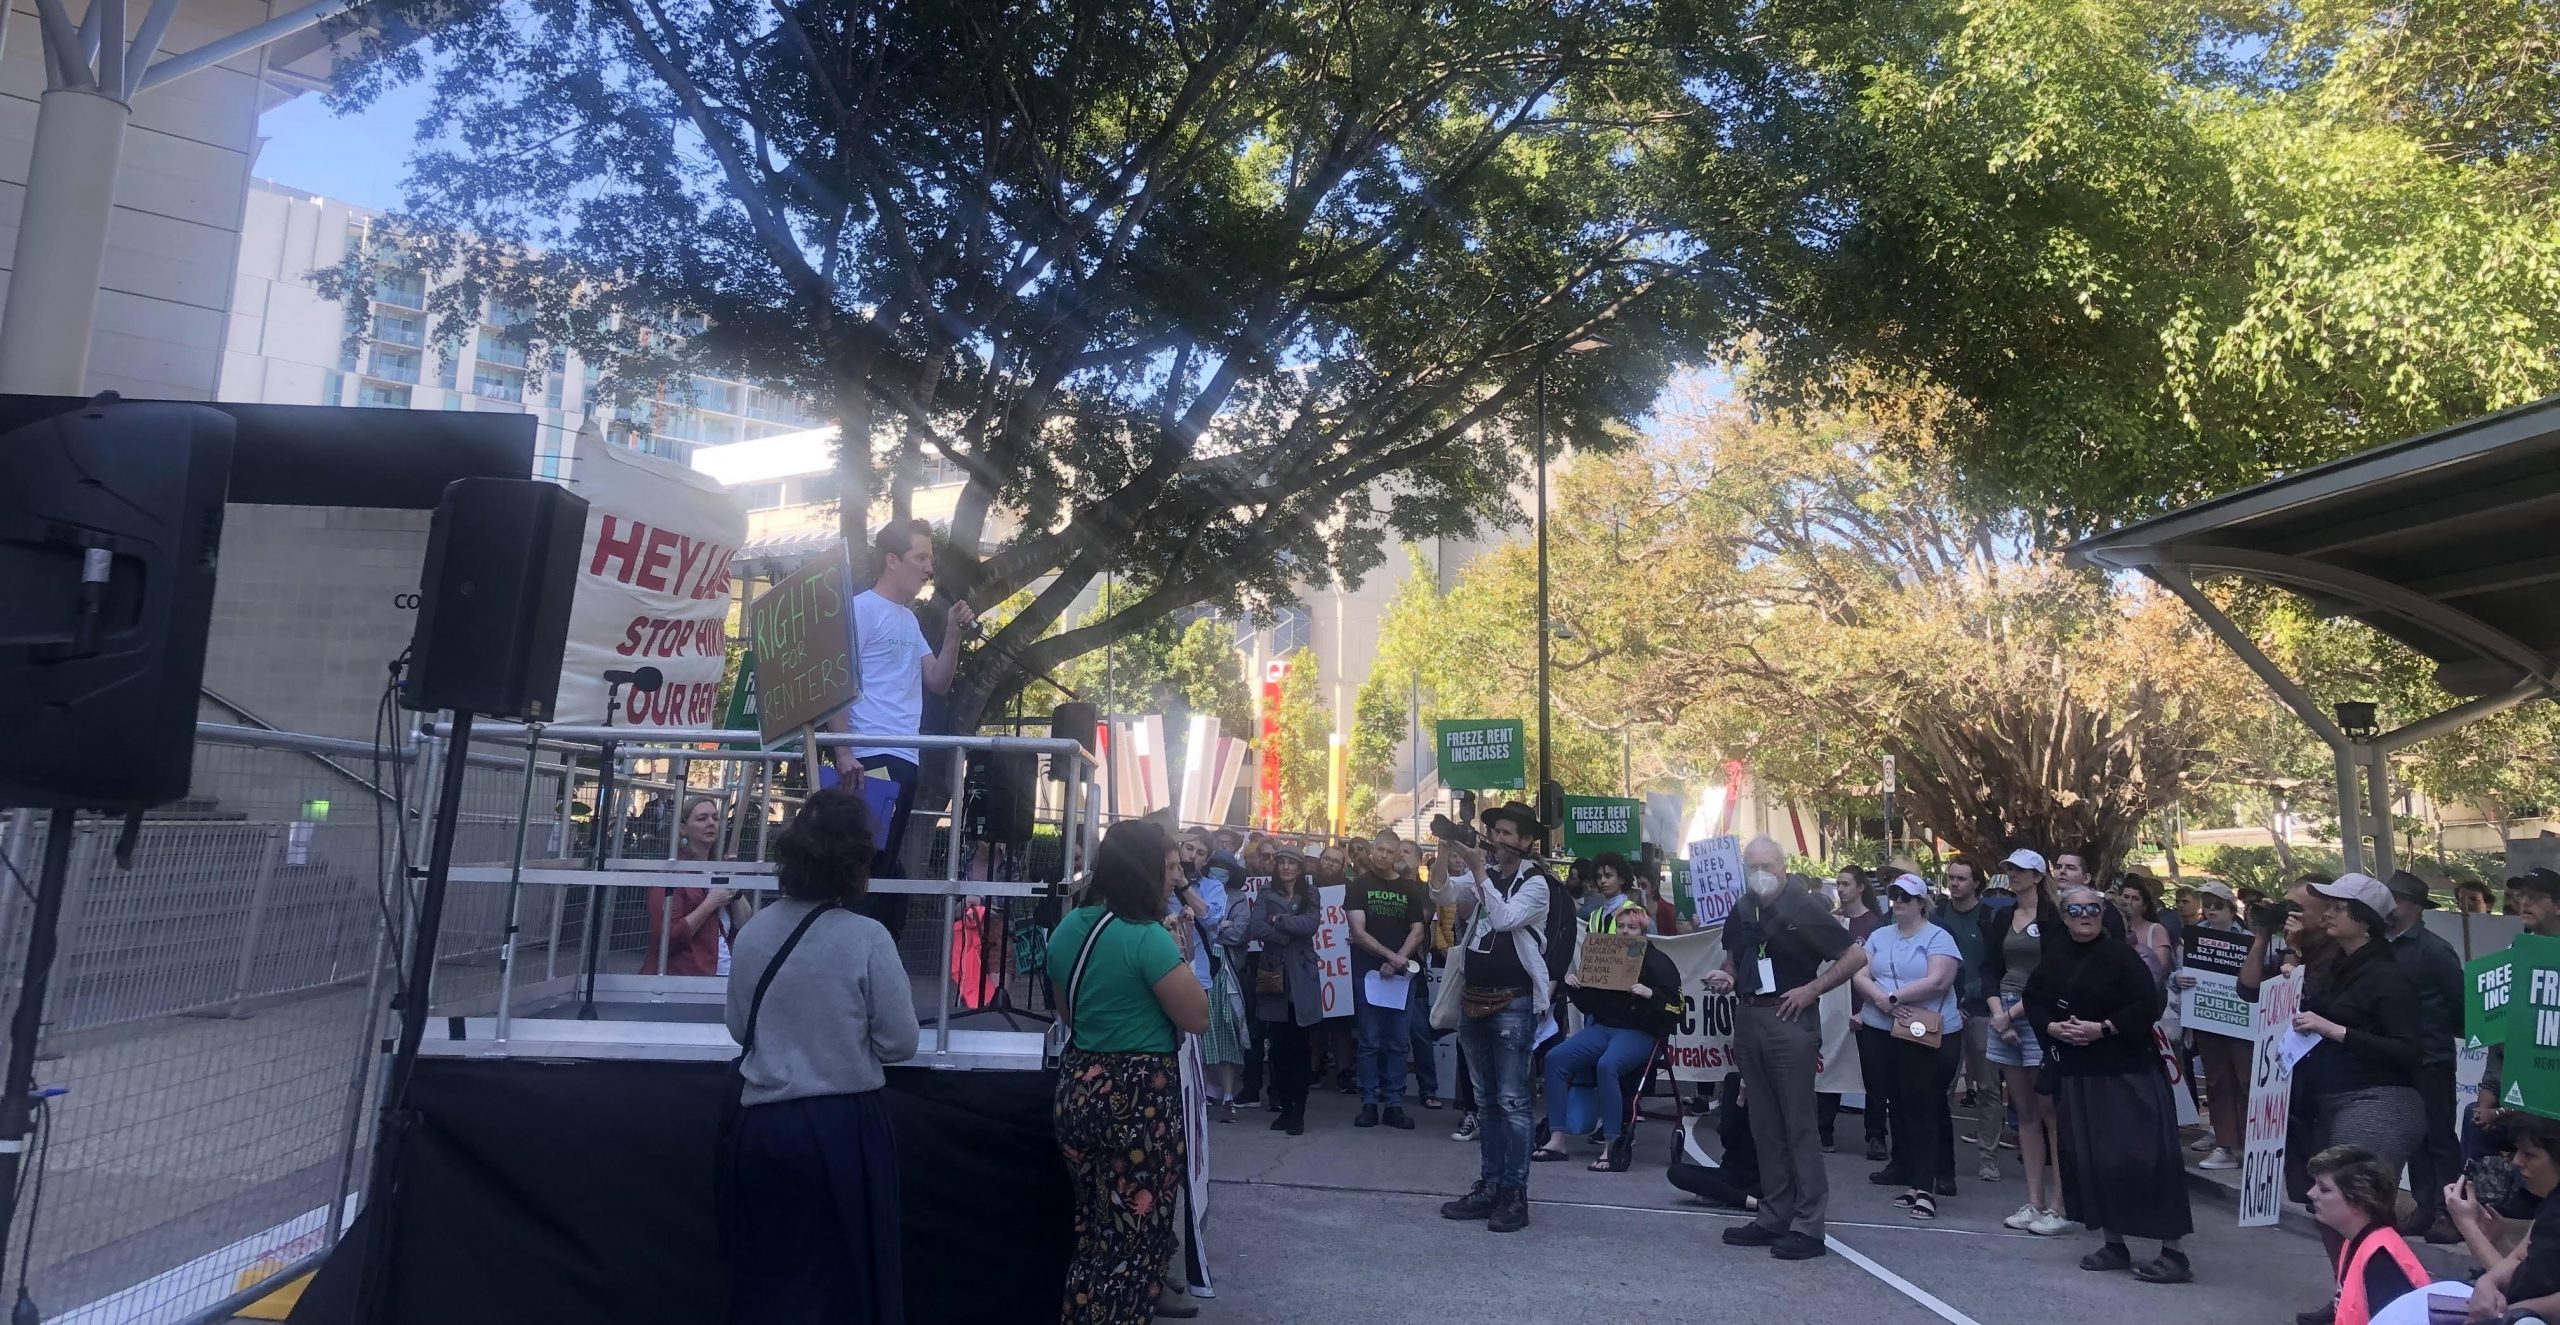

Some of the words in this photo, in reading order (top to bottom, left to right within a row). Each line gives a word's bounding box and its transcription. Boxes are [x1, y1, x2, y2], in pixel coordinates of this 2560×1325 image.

[589, 514, 706, 596] HEY
[757, 567, 841, 663] RIGHTS
[616, 616, 695, 658] STOP
[782, 640, 807, 674] FOR
[763, 653, 850, 725] RENTERS
[626, 682, 683, 726] OUR
[1446, 730, 1484, 747] FREEZE
[1486, 727, 1514, 744] RENT
[1451, 744, 1510, 763] INCREASES
[1571, 806, 1605, 820] FREEZE
[1607, 805, 1632, 820] RENT
[1576, 820, 1628, 834] INCREASES
[1690, 837, 1731, 857] RENTERS
[1696, 856, 1725, 874] NEED
[1699, 872, 1733, 894] HELP
[1367, 890, 1408, 904] PEOPLE
[2196, 946, 2215, 954] $2.7
[2199, 939, 2229, 948] SCRAP
[2231, 944, 2248, 953] THE
[1581, 975, 1608, 985] LAWS
[2196, 995, 2248, 1013] PUBLIC
[2258, 976, 2302, 1034] HOUSING
[2195, 1008, 2248, 1025] HOUSING
[2258, 1035, 2273, 1088] IS
[2459, 1047, 2488, 1061] MUST
[2250, 1088, 2288, 1142] HUMAN
[2243, 1148, 2284, 1221] RIGHT
